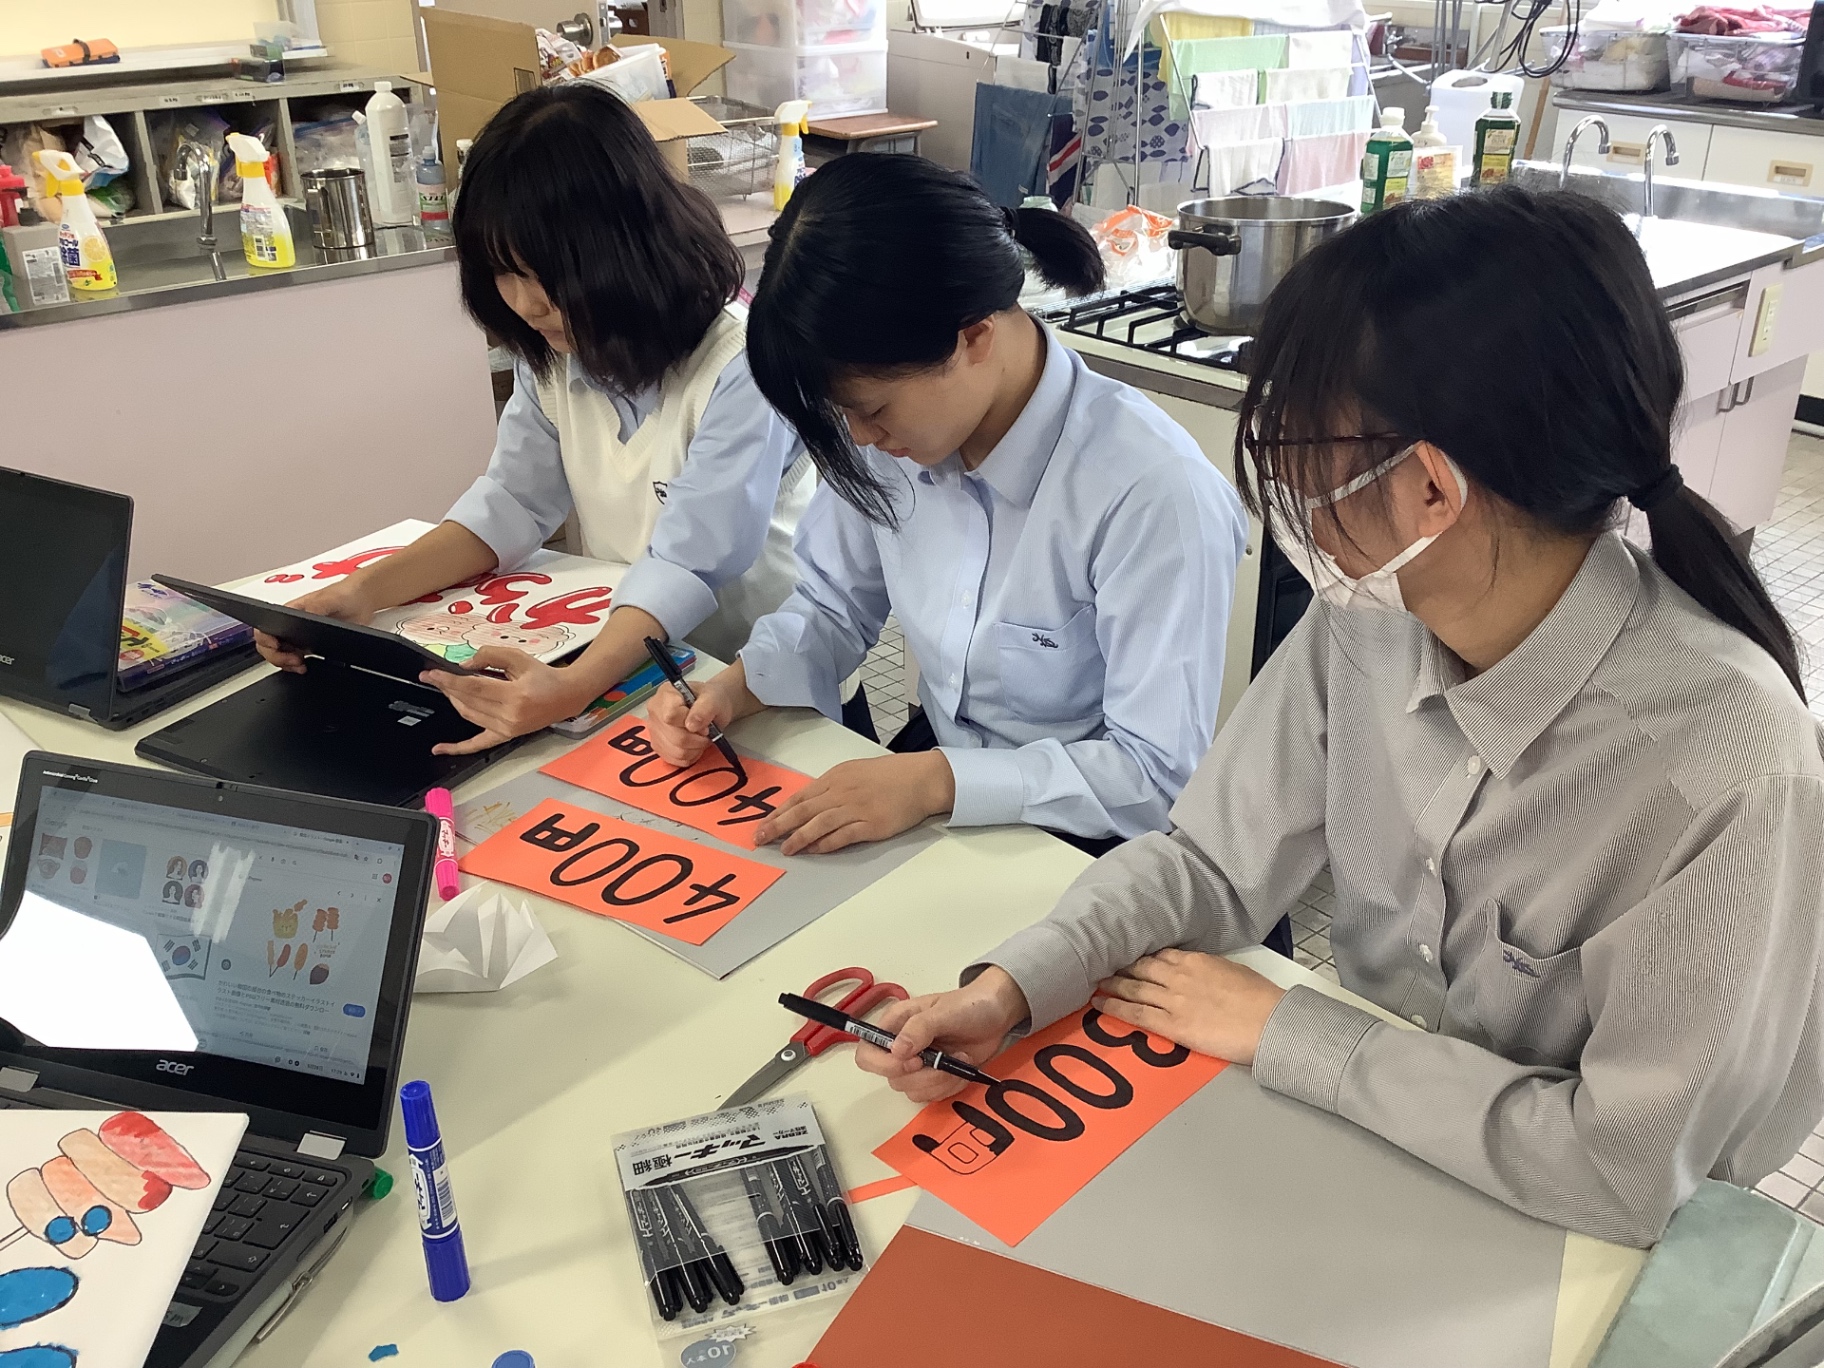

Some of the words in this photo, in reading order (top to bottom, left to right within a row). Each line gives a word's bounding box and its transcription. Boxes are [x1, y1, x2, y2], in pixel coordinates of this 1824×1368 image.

[520, 812, 741, 924] 400円
[155, 1058, 195, 1077] acer
[773, 1129, 809, 1141] ZEBRA
